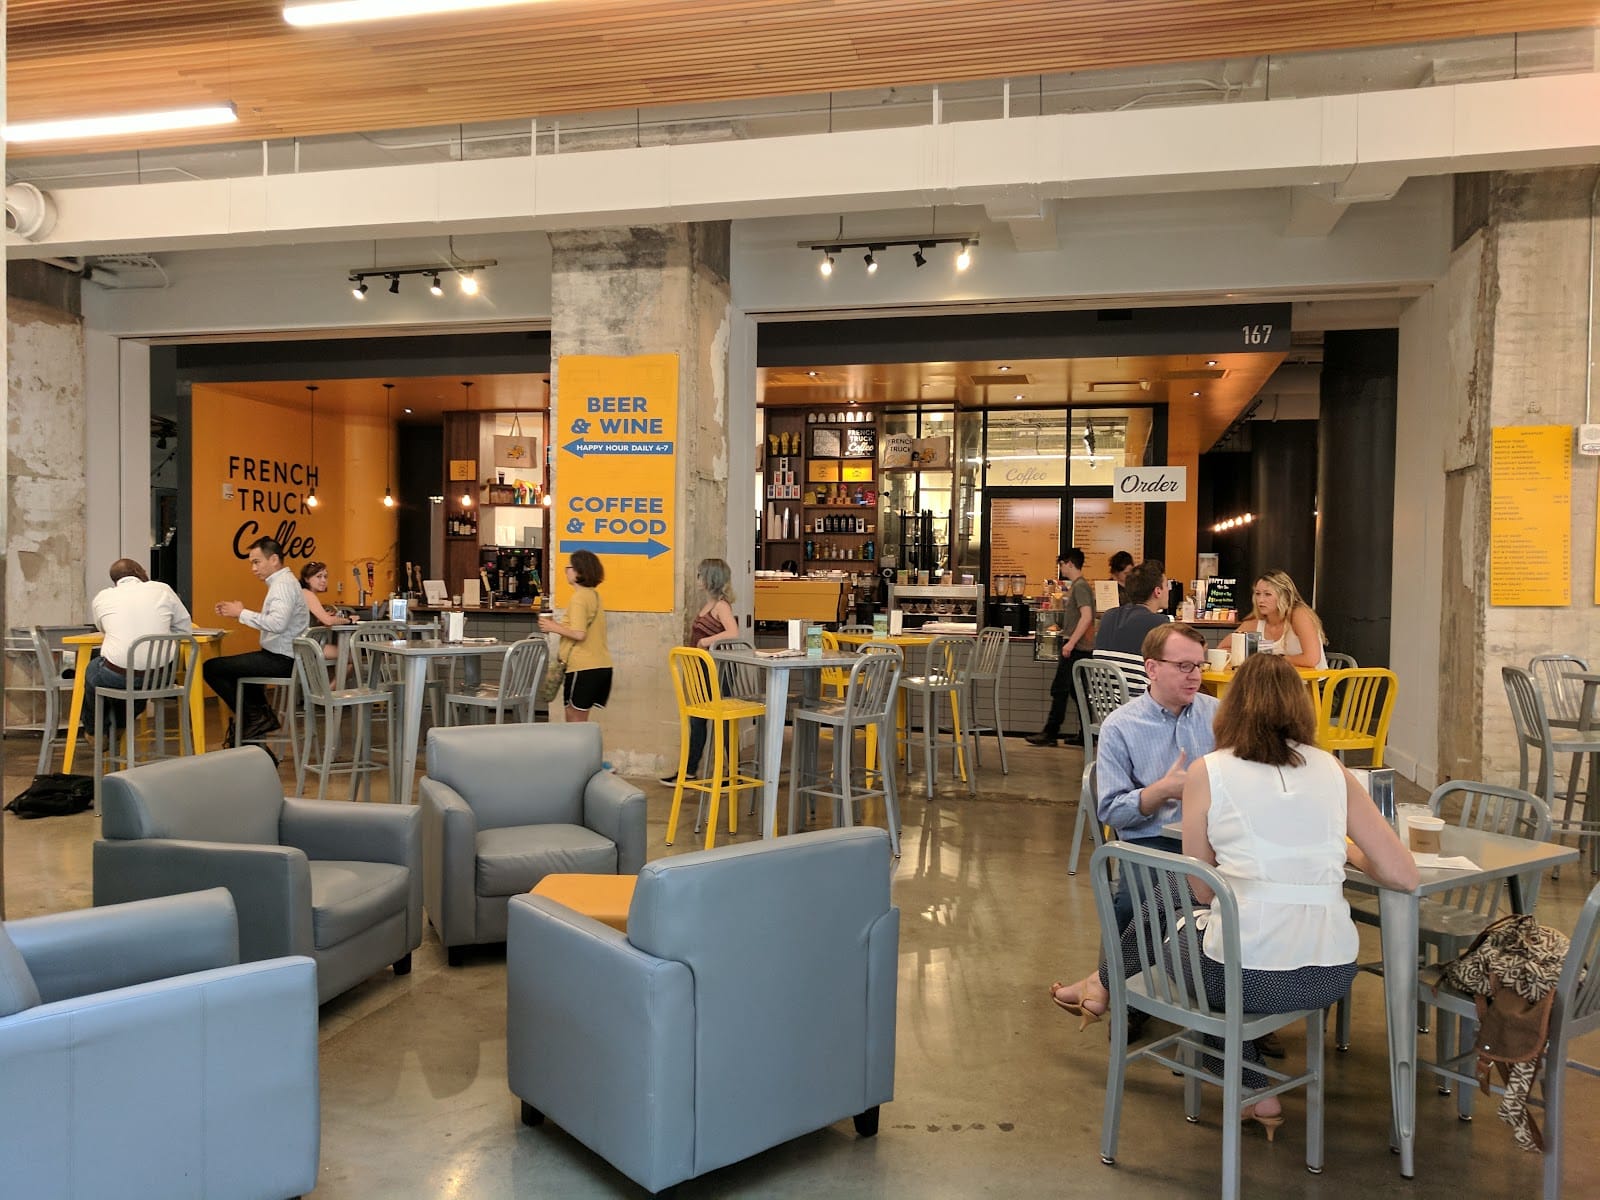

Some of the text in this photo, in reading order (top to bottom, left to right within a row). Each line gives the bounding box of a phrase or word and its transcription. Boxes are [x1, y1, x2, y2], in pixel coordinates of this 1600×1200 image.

[1242, 325, 1273, 344] 167
[587, 397, 648, 413] BEER
[571, 418, 663, 434] & WINE
[229, 455, 318, 487] FRENCH
[1006, 467, 1048, 484] Coffee
[1120, 474, 1179, 493] Order
[237, 487, 312, 515] TRUCK
[569, 496, 663, 514] COFFEE
[566, 517, 667, 535] & FOOD
